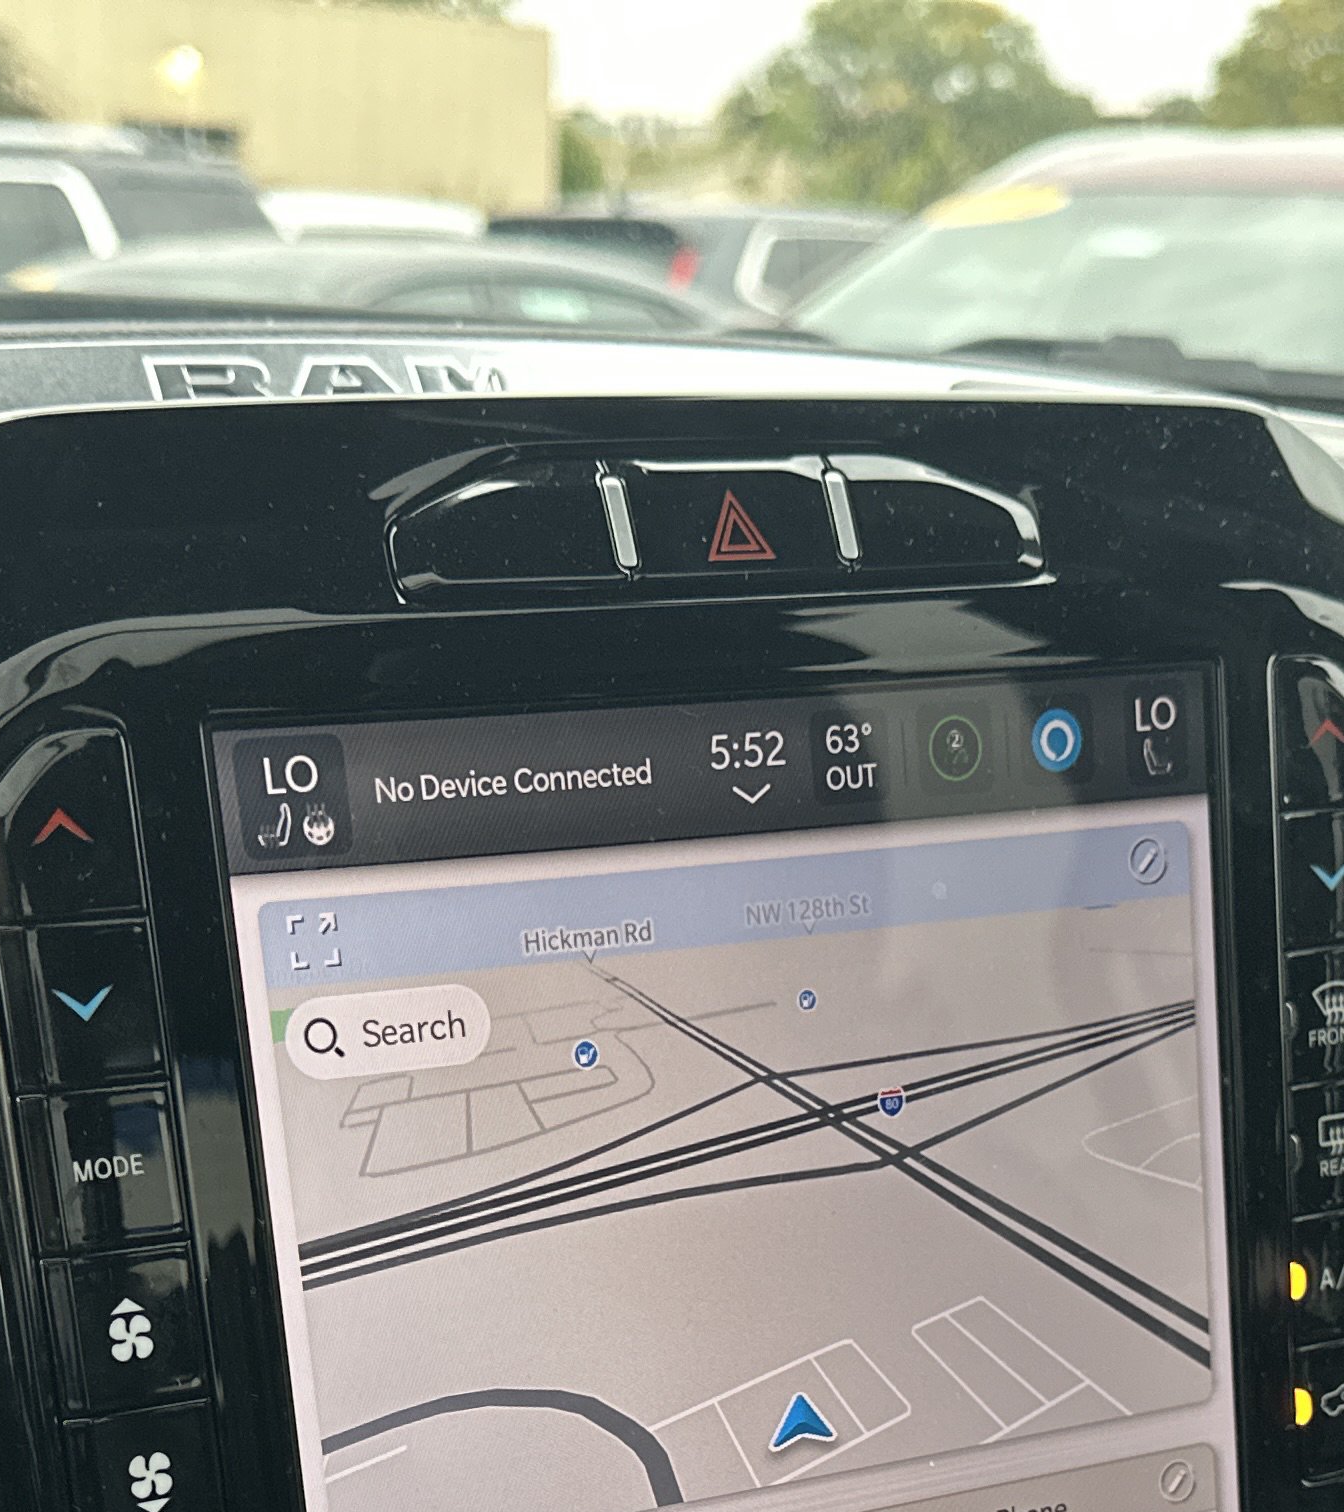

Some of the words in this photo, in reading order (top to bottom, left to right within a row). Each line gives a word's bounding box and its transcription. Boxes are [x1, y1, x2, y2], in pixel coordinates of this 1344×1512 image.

[143, 355, 507, 400] RAM
[1134, 696, 1177, 732] LO
[710, 731, 787, 771] 5:52
[825, 722, 872, 754] 63°
[262, 755, 318, 795] LO
[375, 775, 415, 804] No
[420, 769, 507, 801] Device
[514, 758, 653, 794] Connected
[826, 763, 877, 791] OUT
[745, 903, 780, 926] NW
[787, 897, 843, 922] 128th
[845, 894, 870, 917] St
[523, 926, 618, 955] Hickman
[624, 920, 654, 947] Rd
[361, 1010, 467, 1048] Search
[884, 1097, 900, 1110] 80
[73, 1153, 145, 1184] MODE
